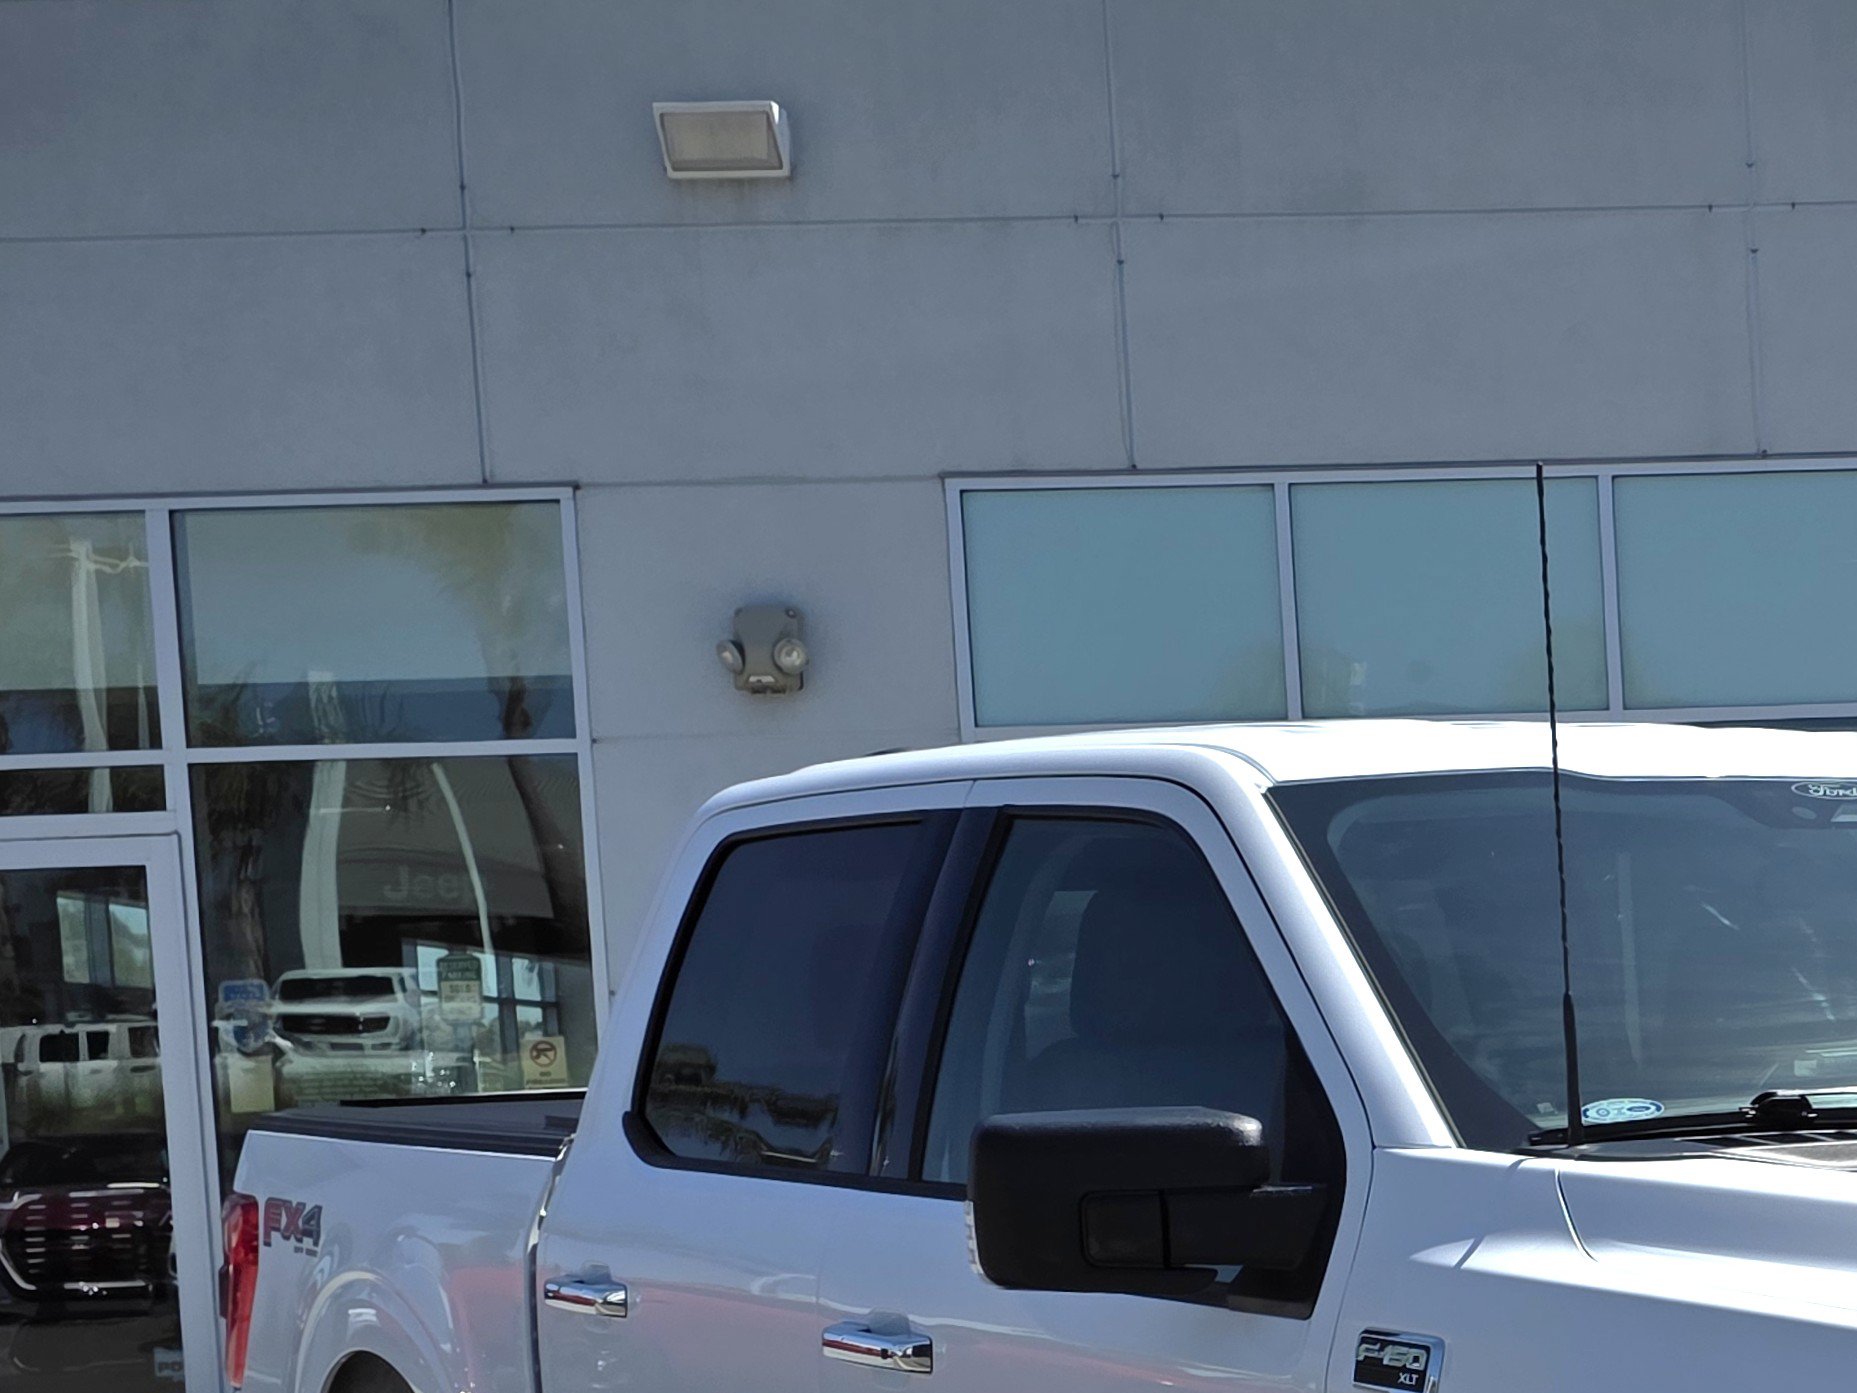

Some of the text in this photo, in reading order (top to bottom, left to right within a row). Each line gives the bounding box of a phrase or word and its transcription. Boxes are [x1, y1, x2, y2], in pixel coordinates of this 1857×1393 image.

[263, 1197, 323, 1248] FX4
[1357, 1342, 1427, 1371] F-150
[1397, 1372, 1419, 1386] XLT
